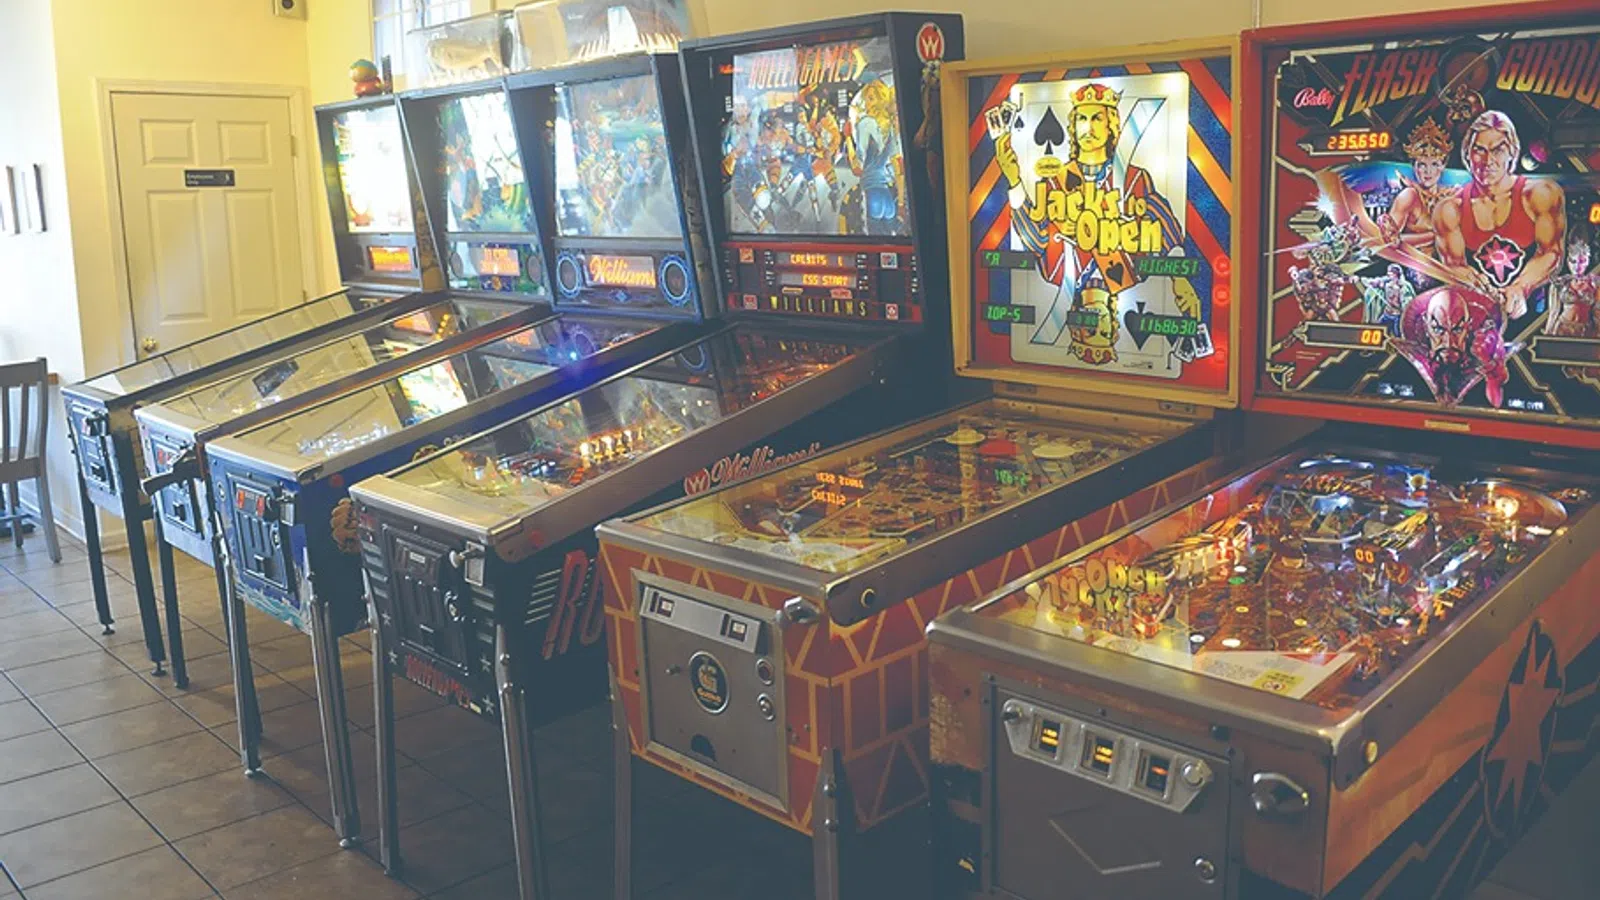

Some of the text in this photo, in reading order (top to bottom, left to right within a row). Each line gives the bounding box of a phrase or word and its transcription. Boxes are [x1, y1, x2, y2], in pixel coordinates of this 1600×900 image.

[1293, 86, 1336, 110] Bally
[1330, 50, 1440, 128] FLASH
[1029, 180, 1121, 222] Jacks
[1076, 208, 1163, 255] Open
[770, 296, 867, 317] WILLIAMS
[1361, 329, 1381, 345] 00
